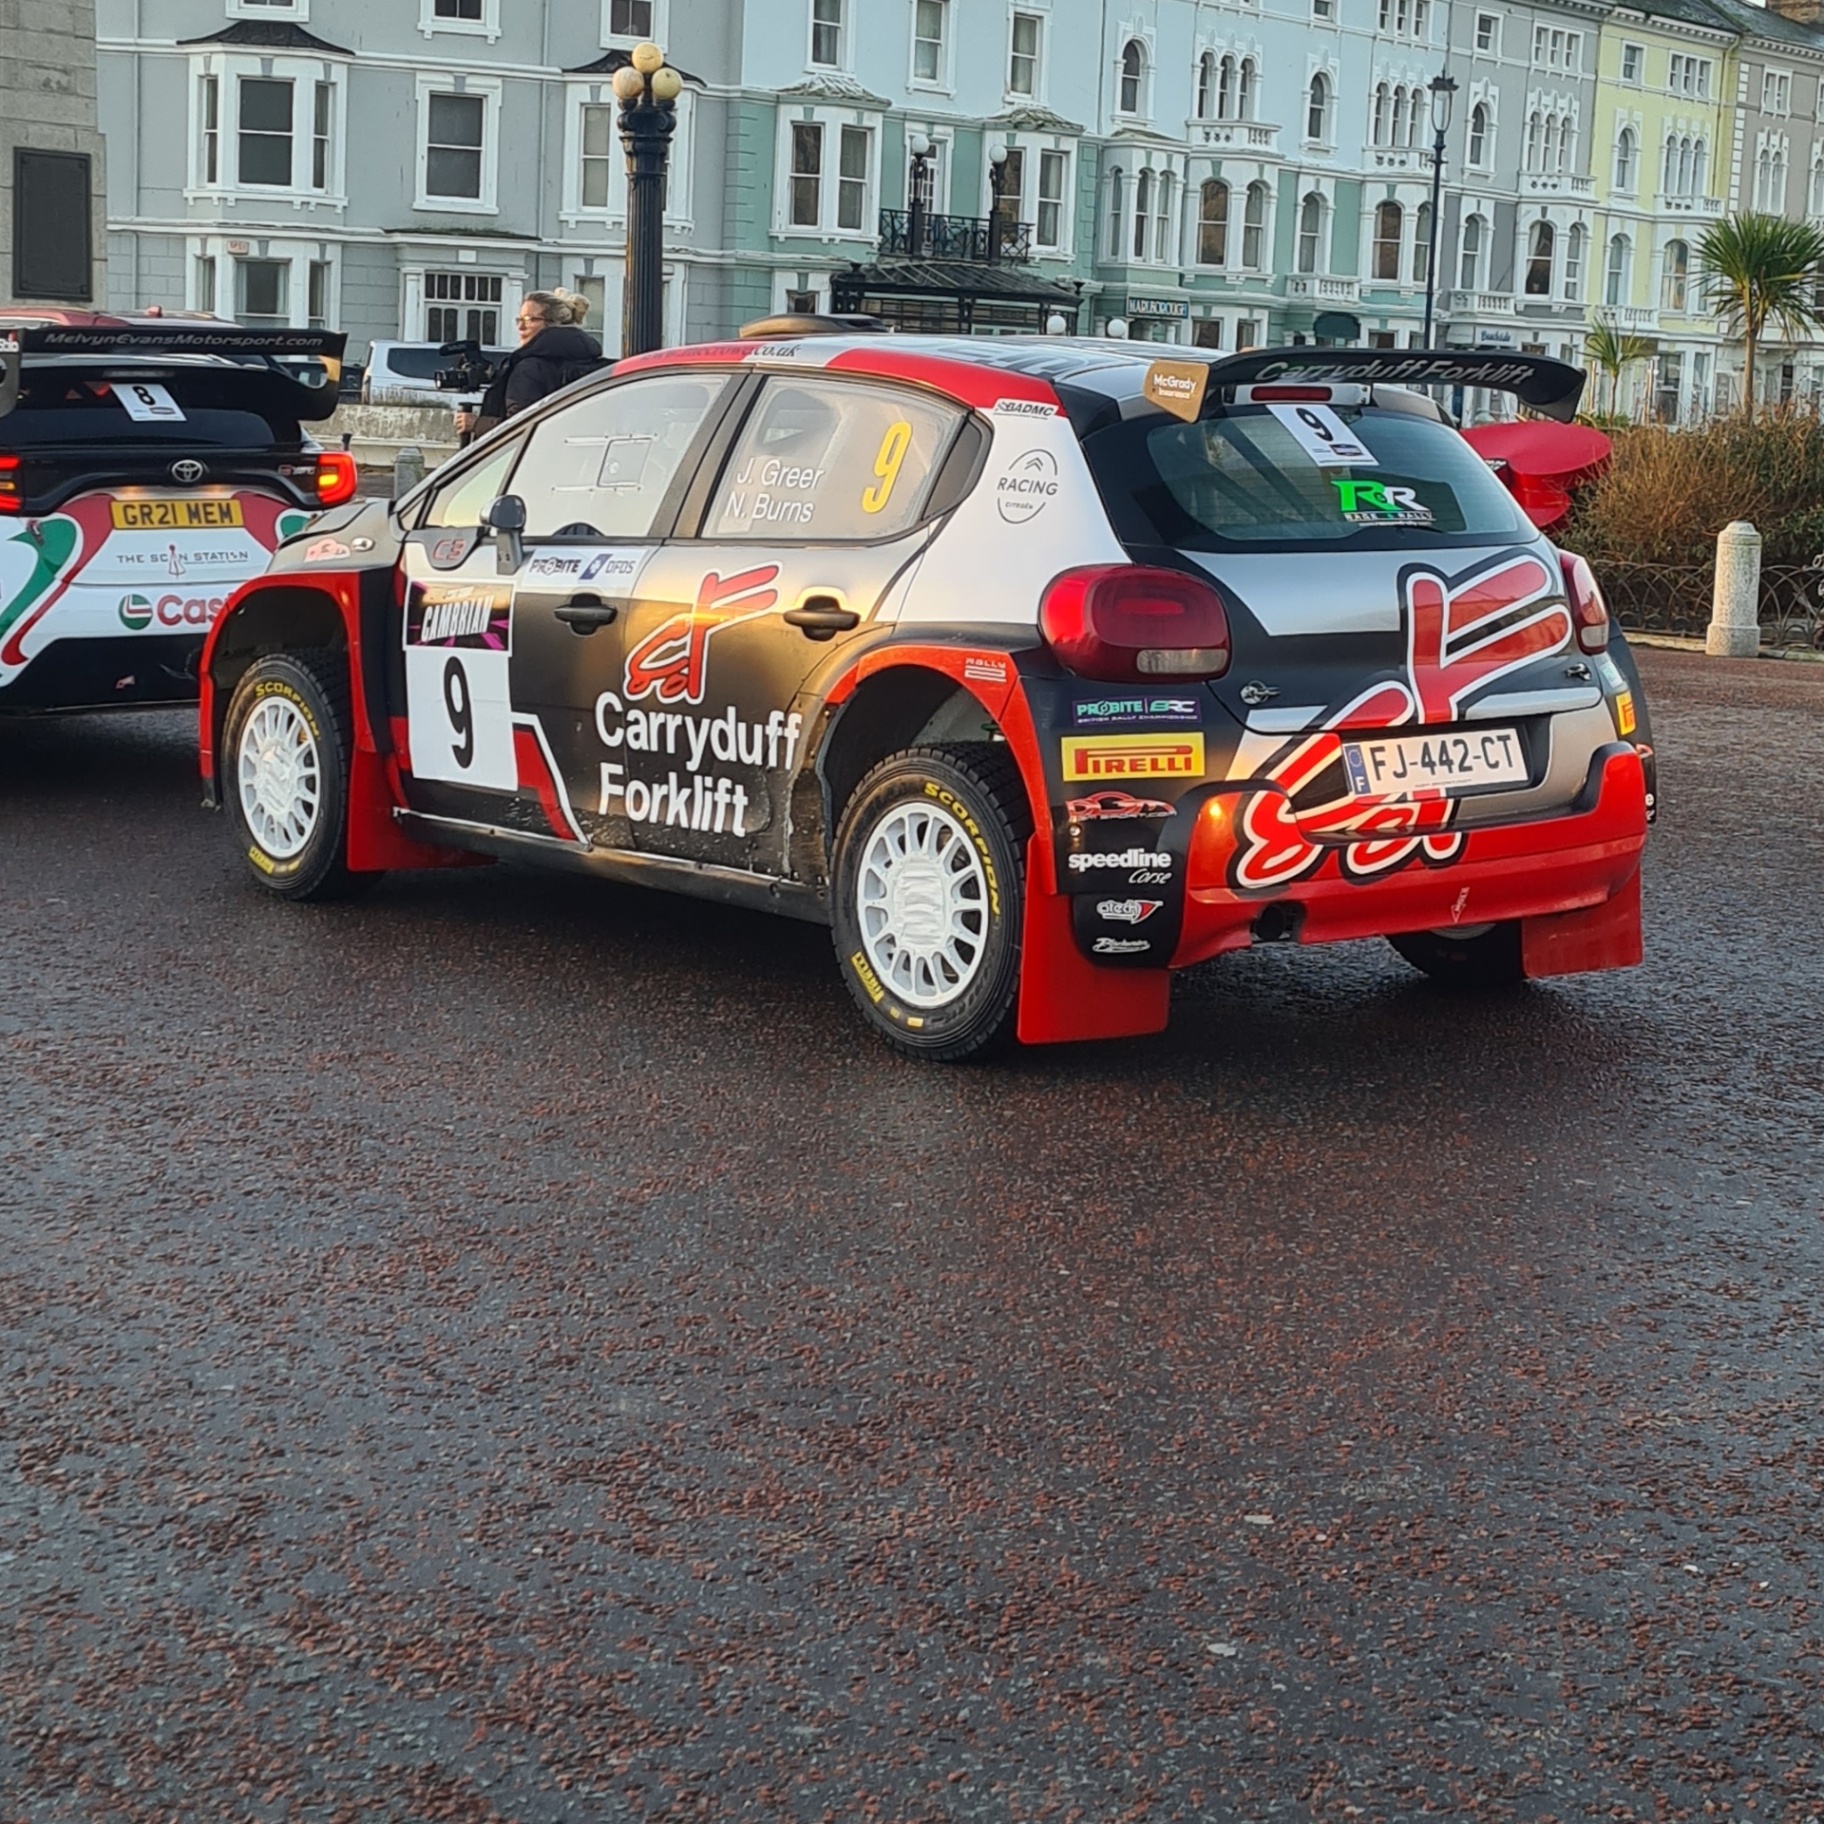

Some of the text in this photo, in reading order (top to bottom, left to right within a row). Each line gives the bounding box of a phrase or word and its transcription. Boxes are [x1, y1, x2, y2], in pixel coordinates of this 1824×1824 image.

[44, 332, 323, 348] MelvynEvansMotorsport.com
[1153, 373, 1197, 393] McGrady
[1255, 359, 1537, 385] Carryduff Forklift
[132, 385, 156, 406] 8
[1295, 407, 1334, 442] 9
[737, 457, 825, 490] J. Greer
[861, 421, 912, 514] 9
[997, 477, 1059, 496] RACING
[122, 502, 234, 526] GR21 MEM
[725, 491, 815, 523] N. Burns
[116, 554, 145, 563] THE
[432, 538, 466, 561] C3
[604, 560, 637, 574] DFDS
[157, 593, 236, 627] Cas
[421, 594, 495, 643] CAMBRIAN
[443, 656, 475, 770] 9
[595, 691, 802, 772] Carryduff
[1074, 745, 1193, 775] PIRELLI
[1369, 734, 1513, 781] FJ-442-CT
[1355, 776, 1366, 792] F
[598, 762, 749, 838] Forklift
[923, 781, 1001, 916] SCORPION
[1068, 848, 1172, 872] speedline
[1128, 867, 1172, 884] Corse
